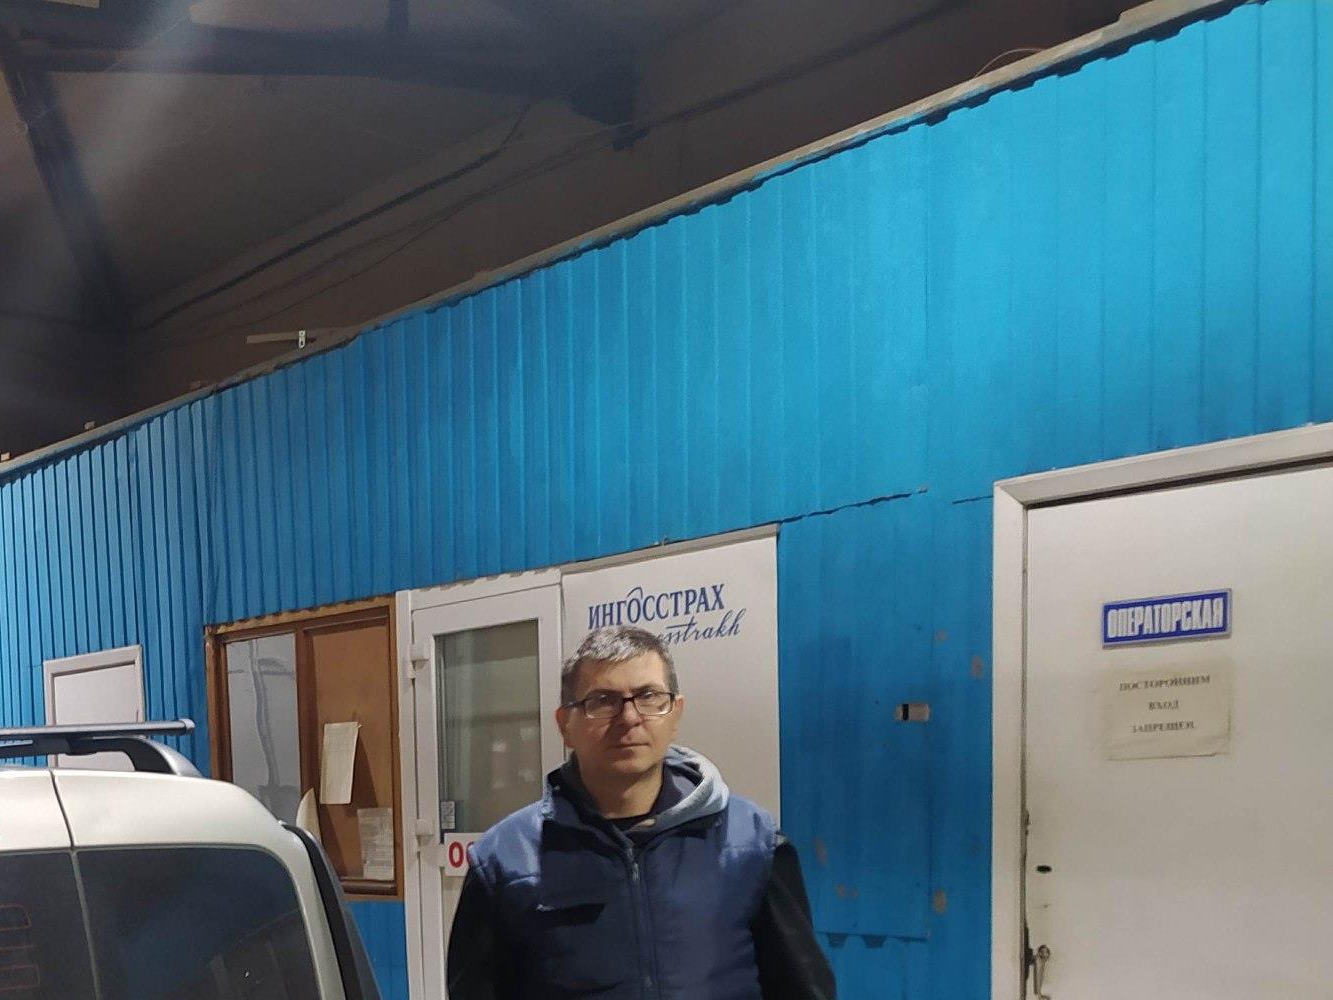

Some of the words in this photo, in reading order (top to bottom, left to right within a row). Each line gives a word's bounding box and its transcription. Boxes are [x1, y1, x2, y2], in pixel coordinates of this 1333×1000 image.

[588, 584, 725, 630] ИНГОССТРАХ
[658, 607, 747, 646] sstrakh
[1106, 597, 1224, 639] ОПЕРАТОРСКАЯ
